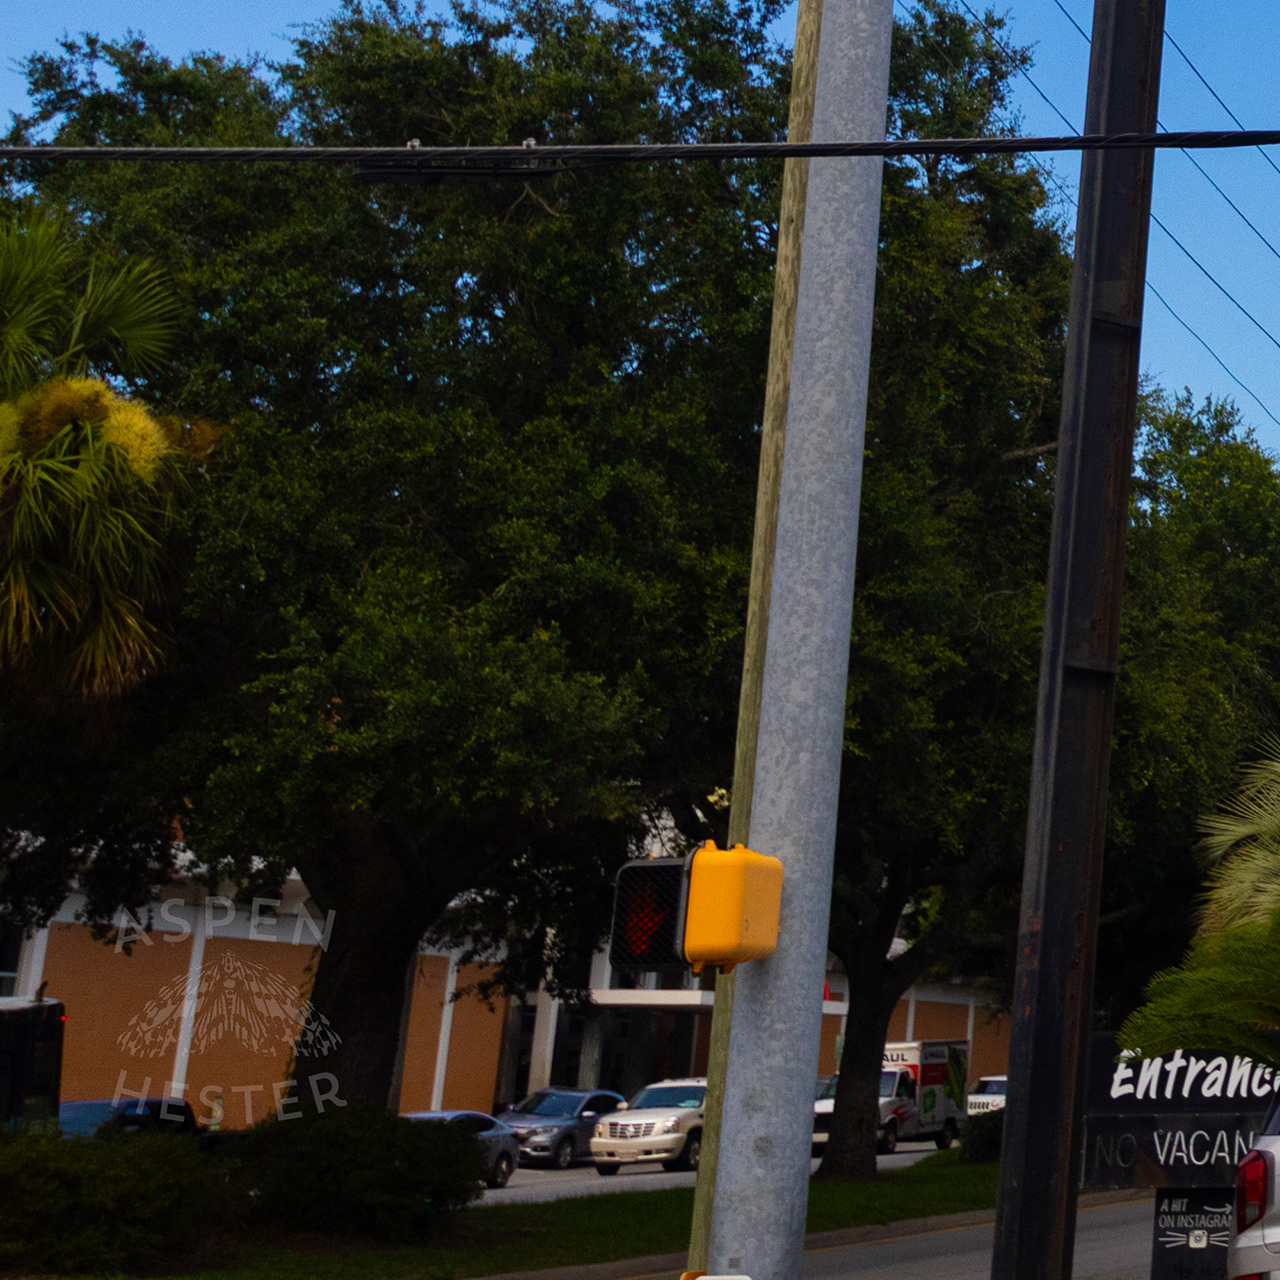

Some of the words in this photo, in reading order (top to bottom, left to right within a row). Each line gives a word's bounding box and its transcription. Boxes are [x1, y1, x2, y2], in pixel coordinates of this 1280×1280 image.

[1096, 1133, 1137, 1169] NO
[1153, 1129, 1254, 1165] VACAN
[1160, 1199, 1169, 1212] A
[1171, 1198, 1189, 1212] HIT
[1158, 1214, 1175, 1228] ON
